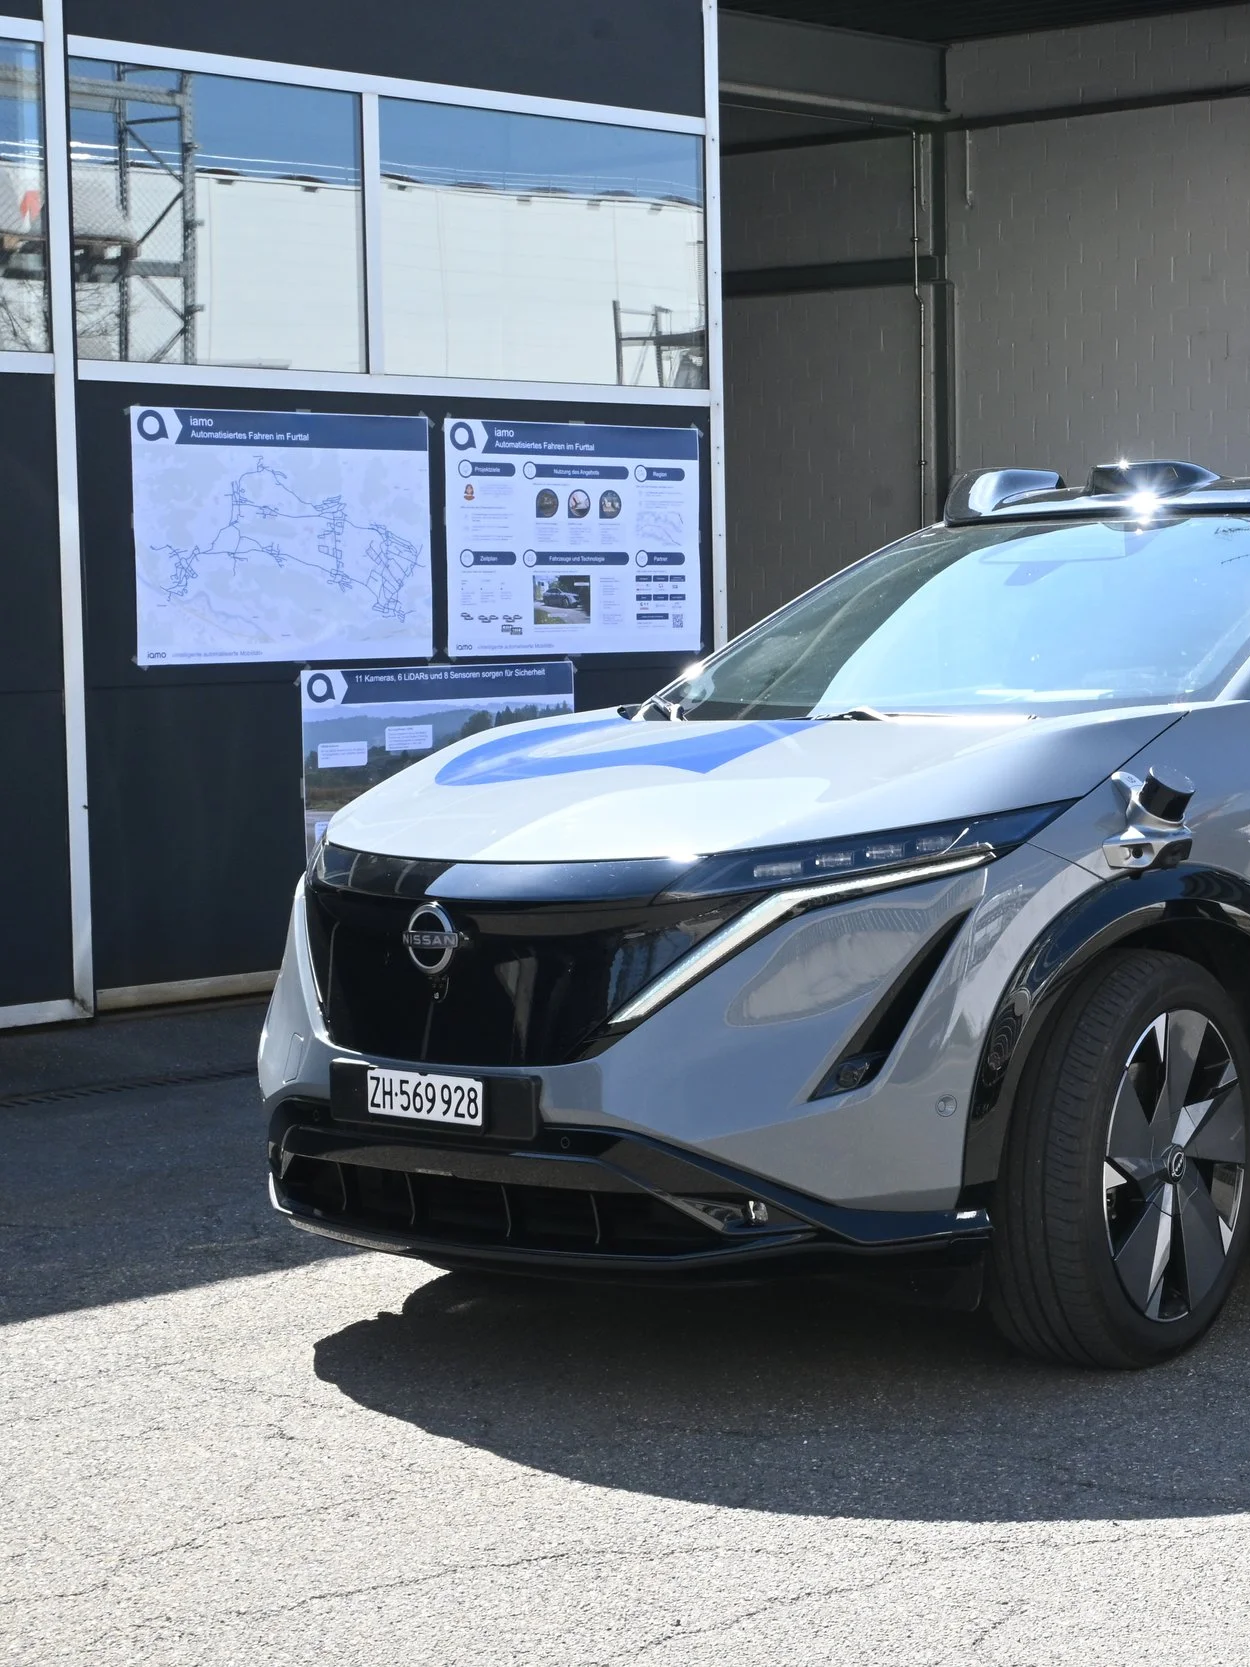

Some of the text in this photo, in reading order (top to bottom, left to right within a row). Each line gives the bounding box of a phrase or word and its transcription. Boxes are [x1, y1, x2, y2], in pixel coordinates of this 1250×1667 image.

[190, 416, 214, 427] iamo
[190, 430, 310, 441] Automatisiertes Fahren im Furttal
[494, 427, 515, 438] iamo
[494, 440, 595, 452] Automatisiertes Fahren im Furttal
[147, 651, 167, 659] iamo
[355, 667, 546, 683] 11 Kameras, 6 LiDARs und 8 Sensoren sorgen für Sicherheit
[402, 933, 455, 946] NISSAN
